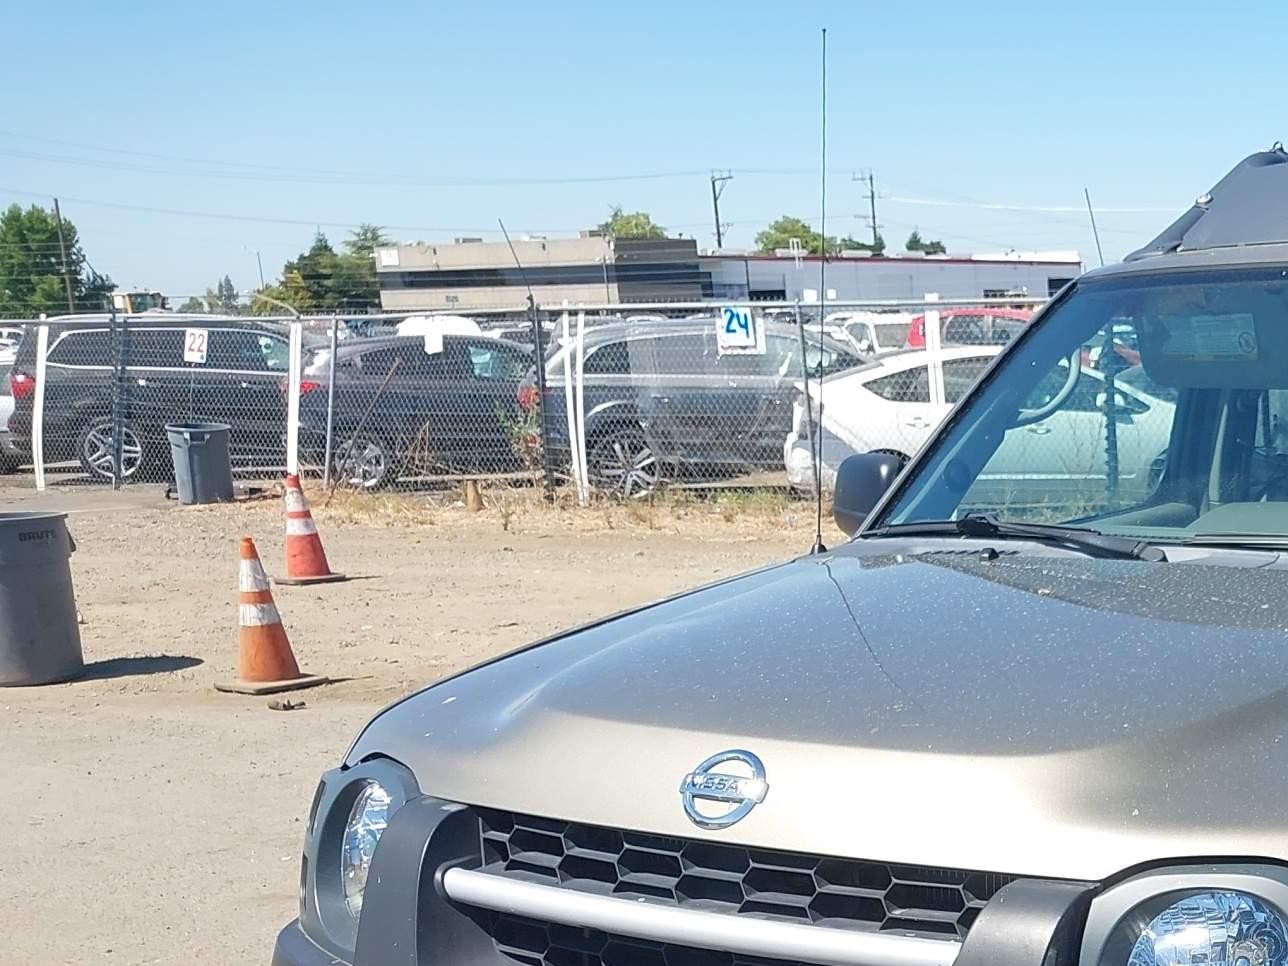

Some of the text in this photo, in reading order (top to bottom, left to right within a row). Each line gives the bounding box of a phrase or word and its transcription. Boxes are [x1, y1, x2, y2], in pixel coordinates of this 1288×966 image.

[723, 308, 750, 339] 24
[187, 332, 205, 353] 22
[684, 775, 751, 796] NISSA
